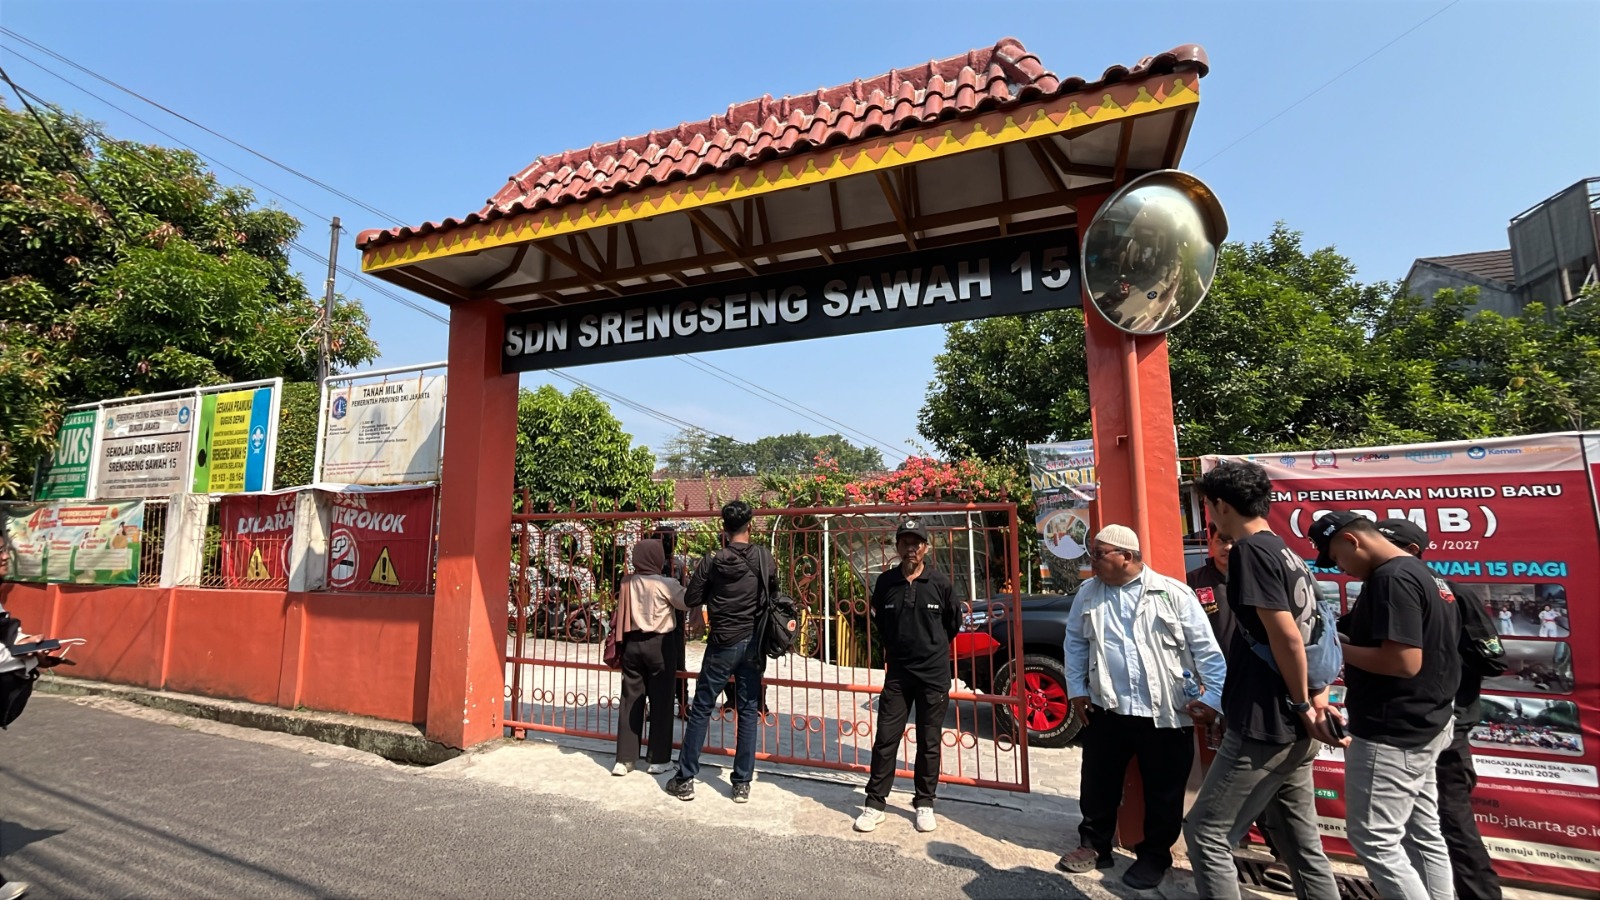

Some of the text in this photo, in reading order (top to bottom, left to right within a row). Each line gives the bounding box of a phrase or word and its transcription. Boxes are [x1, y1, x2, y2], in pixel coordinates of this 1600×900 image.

[505, 246, 1072, 357] SDN SRENGSENG SAWAH 15
[363, 384, 404, 398] TANAH MILIK
[351, 398, 378, 407] PEMERINTAH
[379, 395, 400, 404] PROVINSI
[409, 392, 430, 401] JAKARTA
[233, 415, 245, 425] DEPAN
[58, 426, 91, 466] UKS
[106, 441, 182, 457] SEKOLAH DASAR NEGERI
[108, 458, 177, 472] SRENGSENG SAWAH 15
[1297, 488, 1422, 502] PENERIMAAN
[1427, 486, 1496, 499] MURID
[1501, 484, 1562, 497] BARU
[237, 511, 295, 534] DILARA
[1442, 540, 1479, 550] /2027
[1426, 561, 1567, 577] WAH 15 PAGI
[1038, 701, 1076, 740] RIDGESTONE
[1475, 758, 1522, 768] PENGAJUAN
[1524, 761, 1547, 770] AKUN
[1504, 767, 1561, 779] 2 Juni 2026
[1473, 813, 1600, 837] mb.jakarta.go.i
[1494, 846, 1533, 857] menuju
